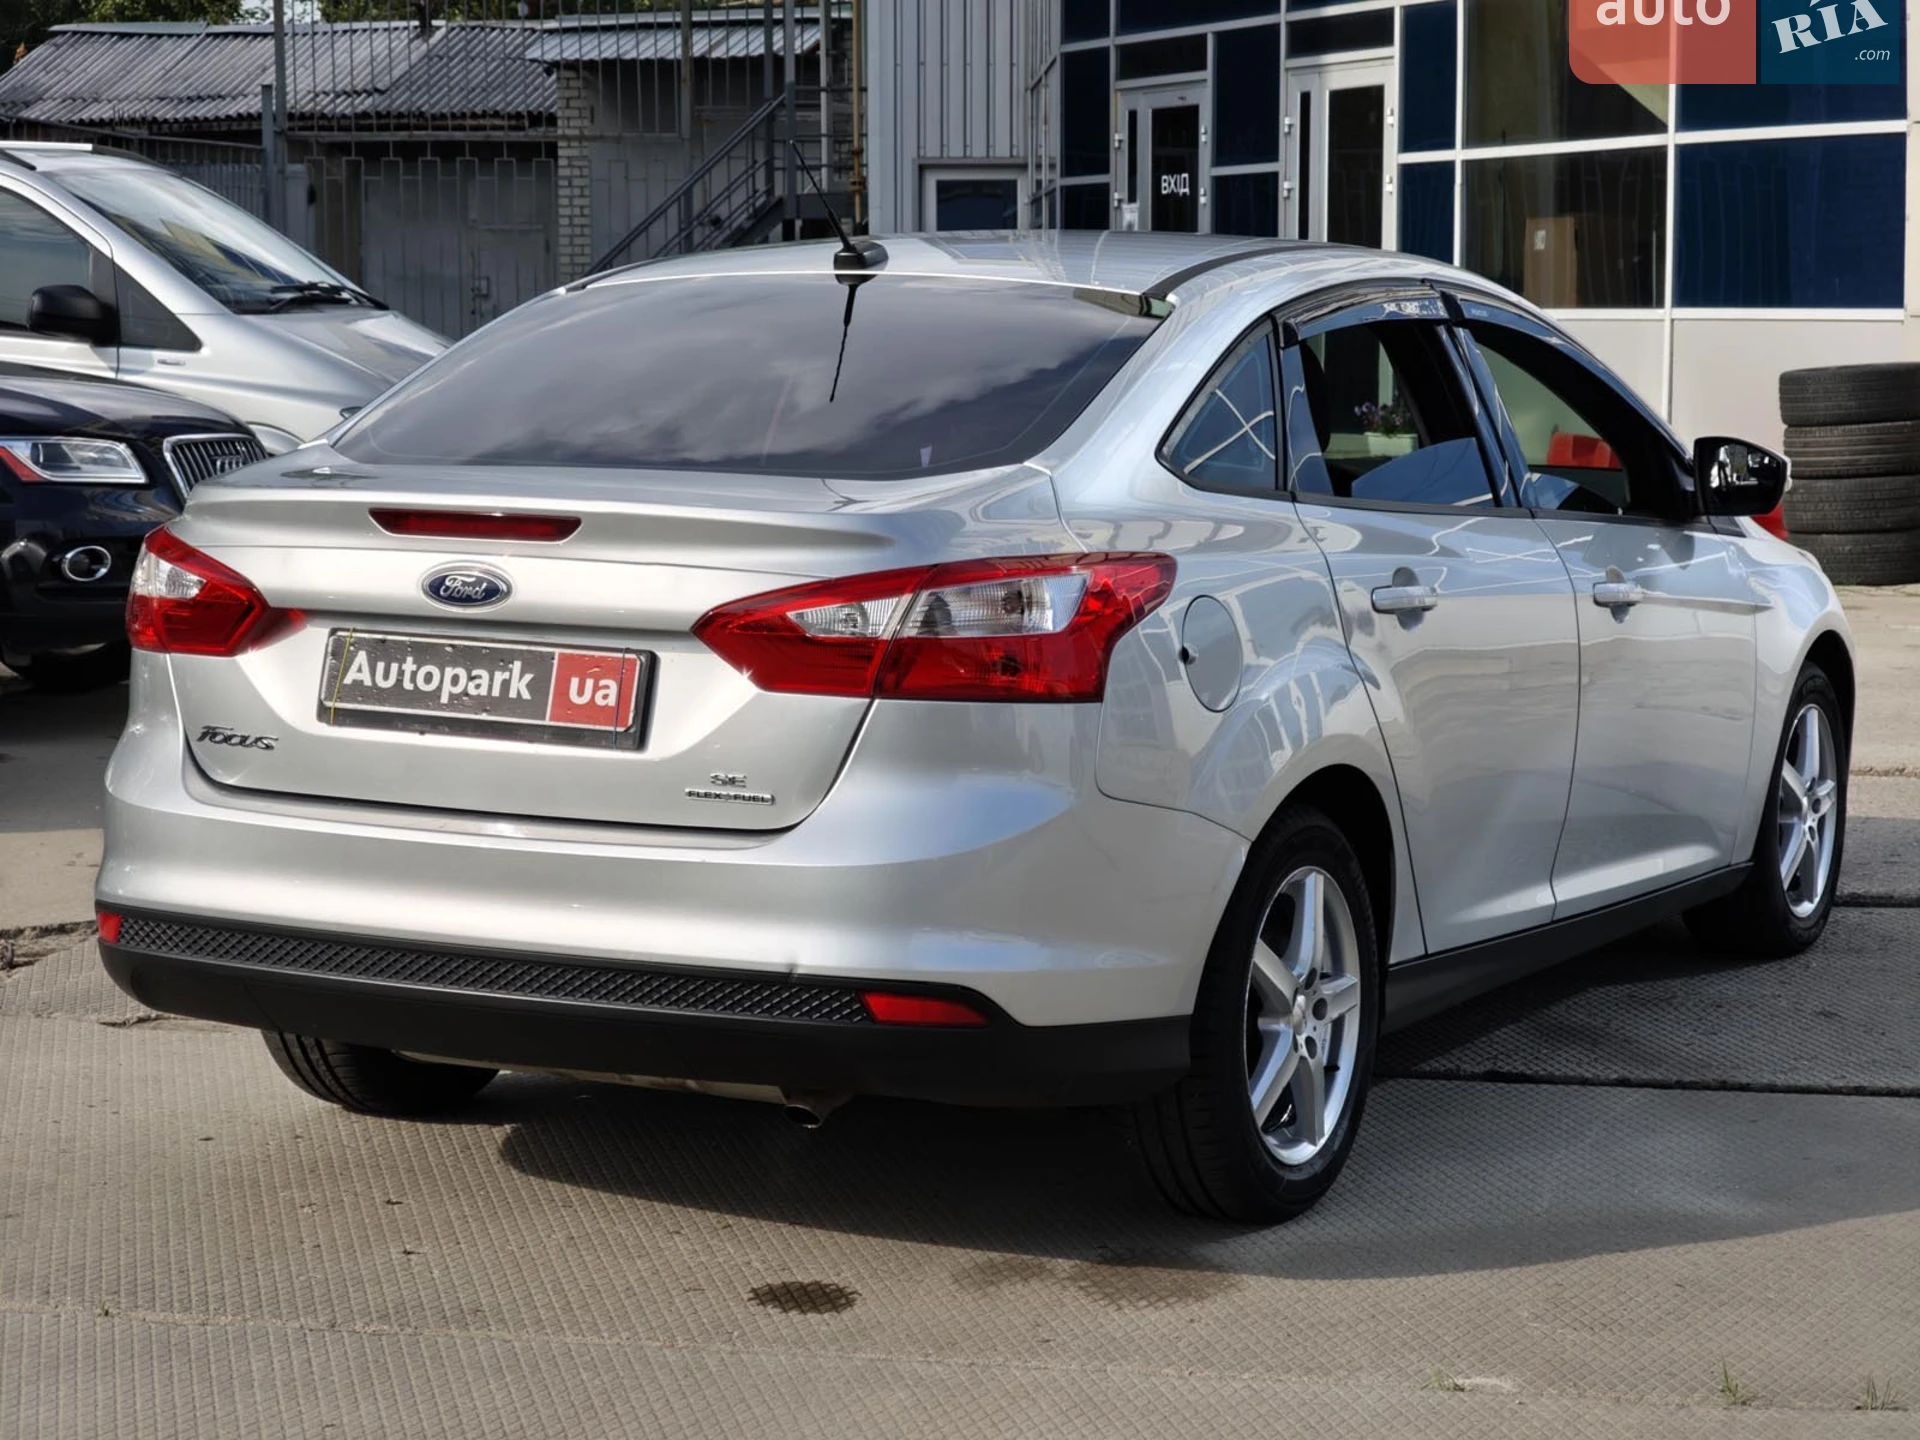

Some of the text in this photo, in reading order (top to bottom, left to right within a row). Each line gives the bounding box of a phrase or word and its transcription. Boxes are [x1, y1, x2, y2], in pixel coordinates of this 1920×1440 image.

[1161, 172, 1190, 196] ВХІД
[440, 575, 487, 600] Ford
[343, 650, 620, 707] Autopark ua
[709, 772, 747, 788] SE
